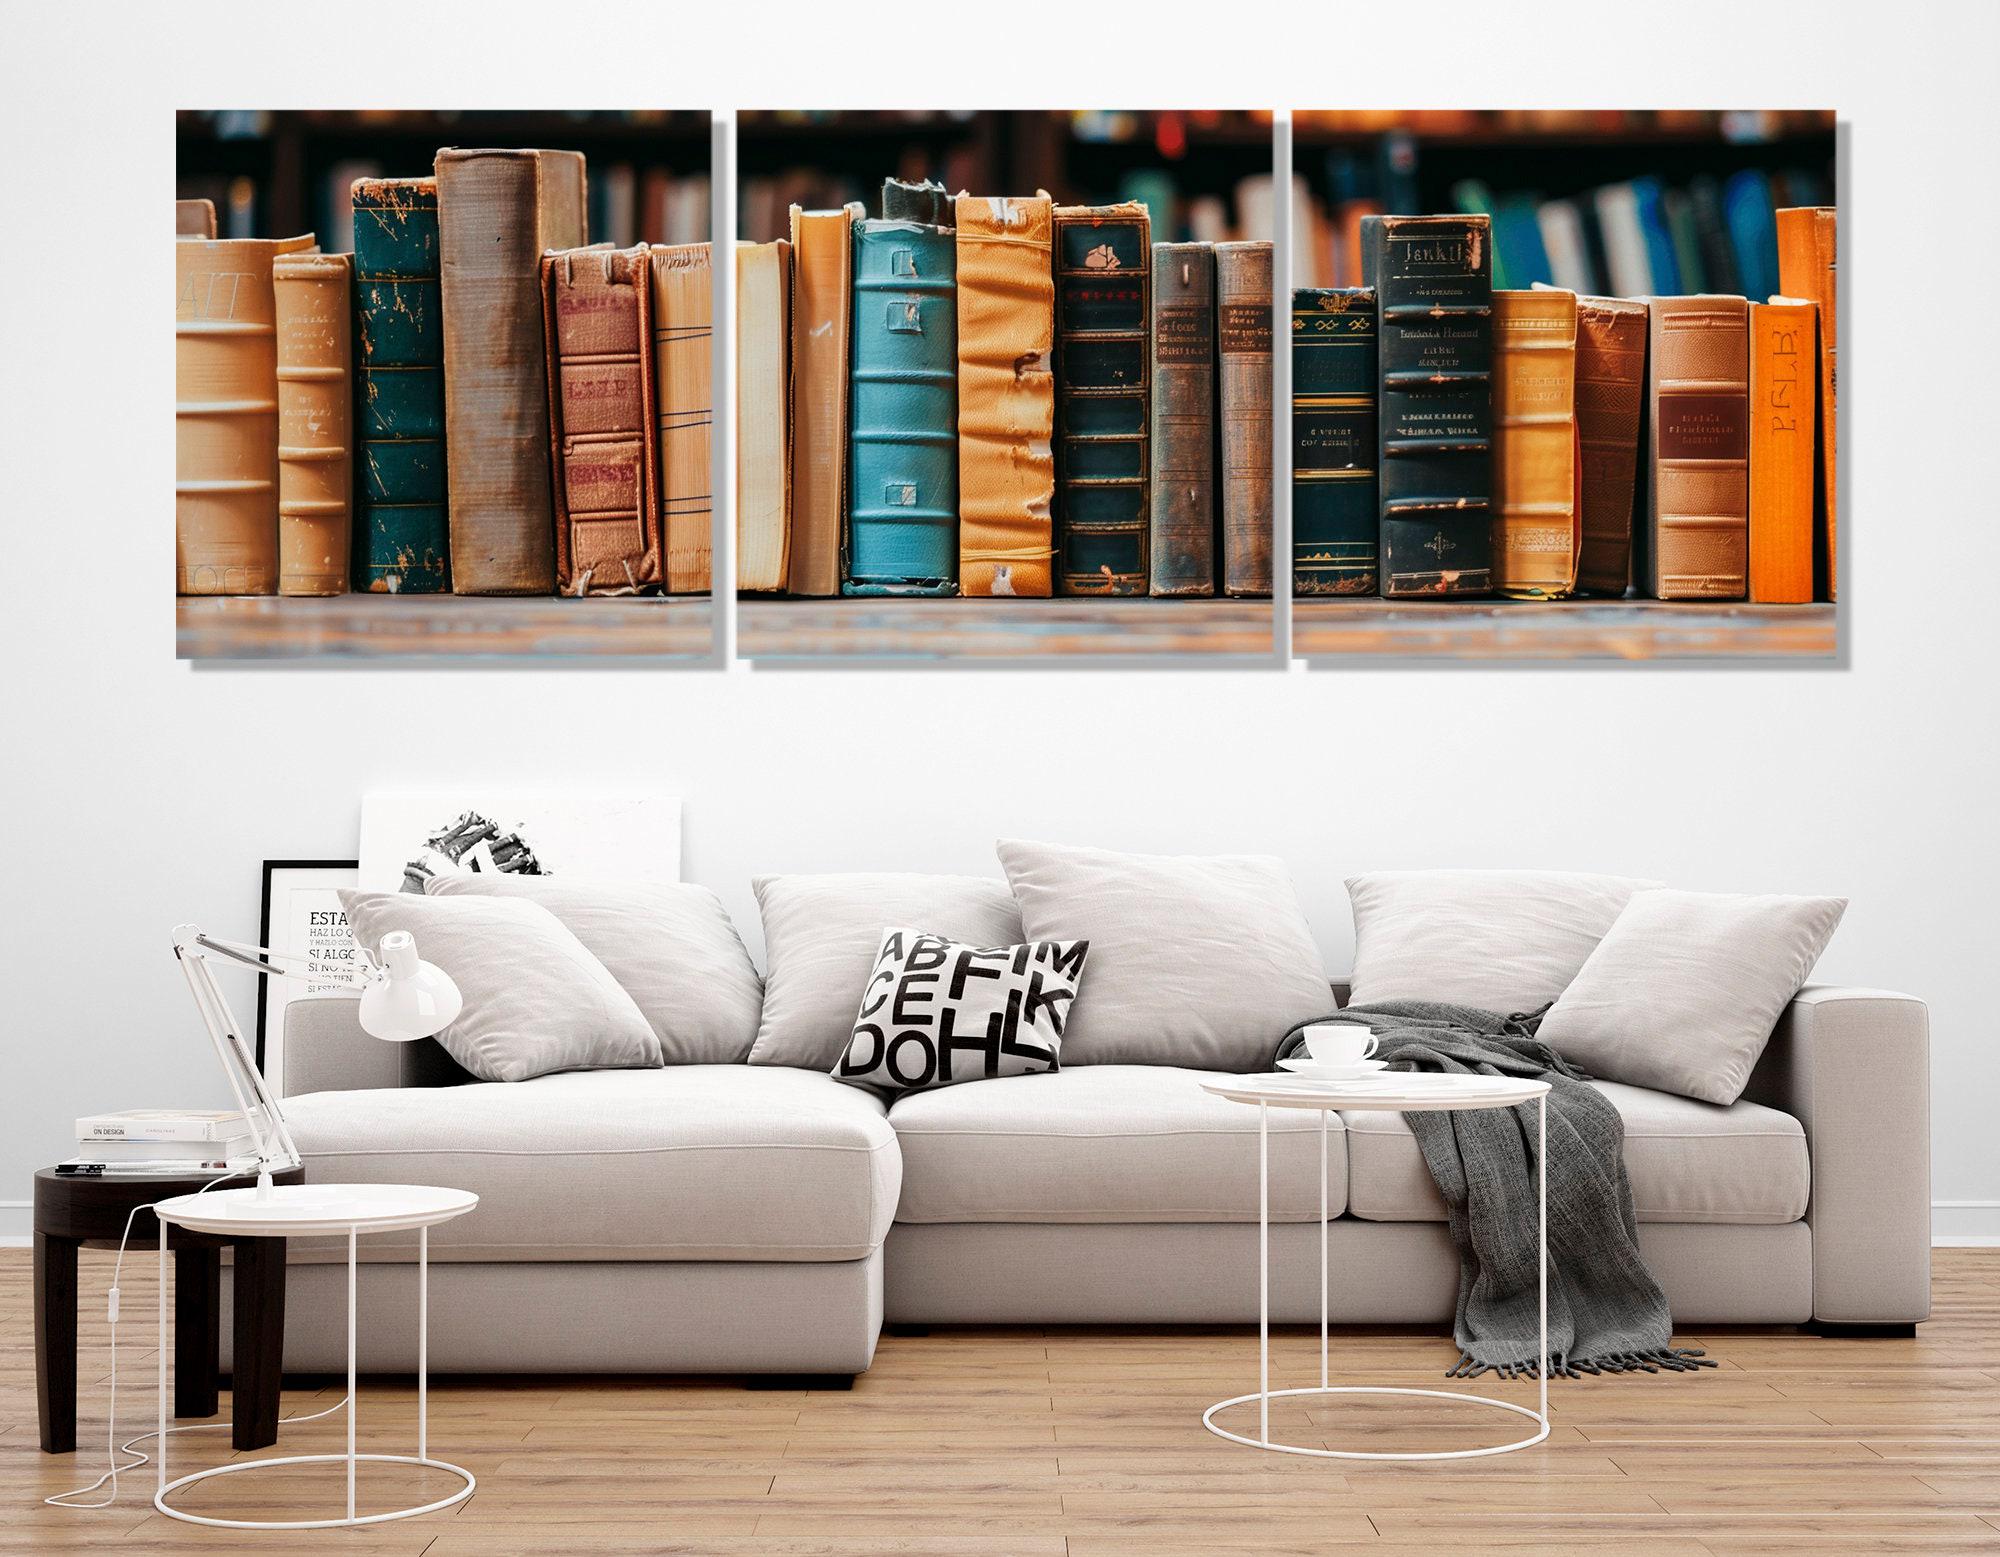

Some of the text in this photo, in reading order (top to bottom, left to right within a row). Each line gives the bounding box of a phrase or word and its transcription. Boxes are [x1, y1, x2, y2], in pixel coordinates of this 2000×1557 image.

[310, 911, 348, 925] ESTA
[309, 928, 329, 937] HAZ
[330, 928, 344, 937] LO
[309, 948, 320, 959] SI
[308, 962, 318, 972] SI
[93, 1128, 125, 1136] ON DESIGN
